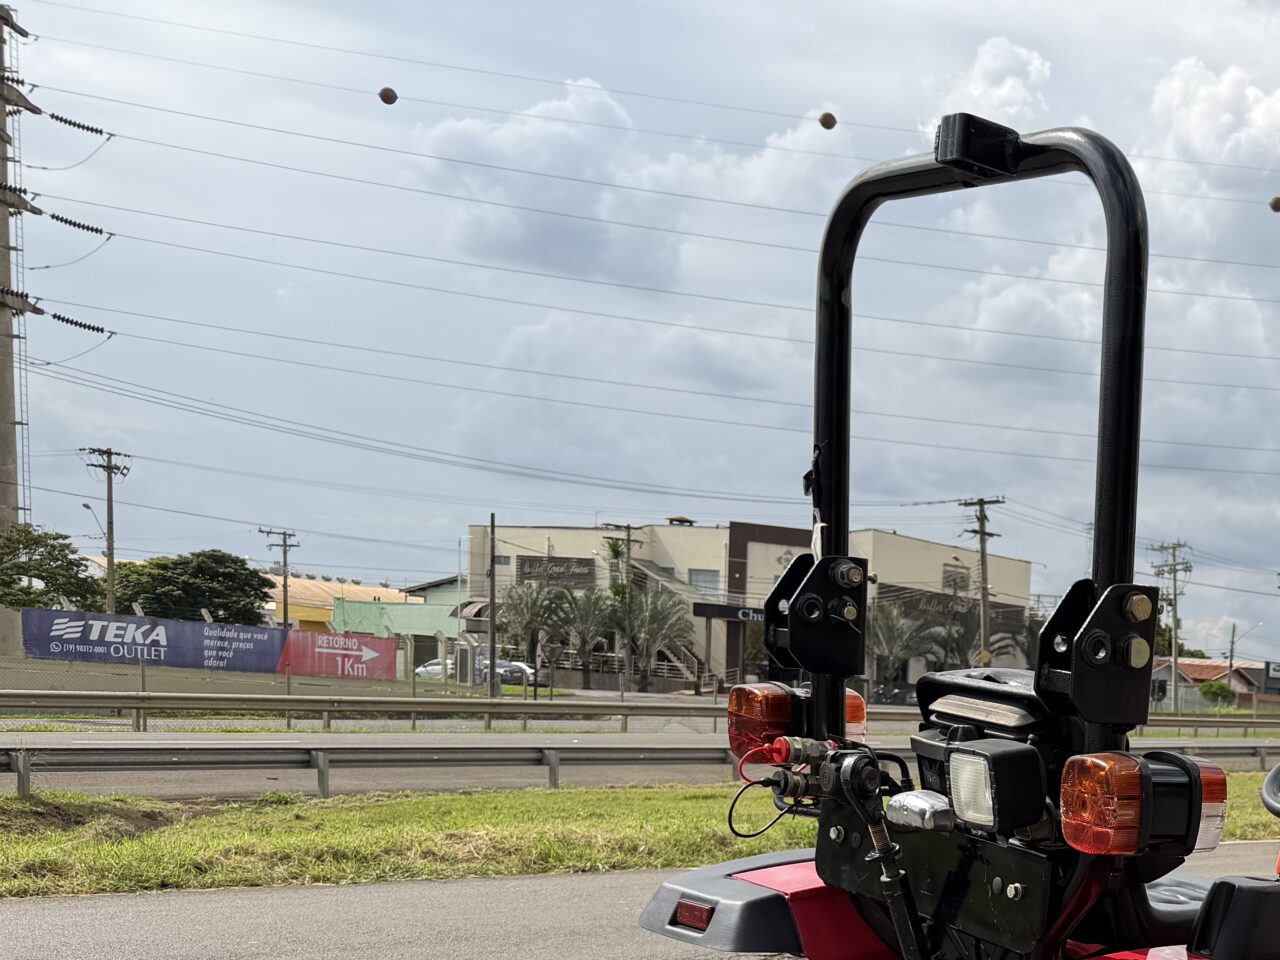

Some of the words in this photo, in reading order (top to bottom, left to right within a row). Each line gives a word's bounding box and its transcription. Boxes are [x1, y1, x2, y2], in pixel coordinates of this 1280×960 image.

[88, 620, 167, 645] TEKA
[203, 627, 238, 638] Qualidade
[240, 631, 251, 640] que
[253, 632, 268, 640] você
[63, 643, 75, 652] (19)
[203, 639, 230, 648] merece,
[232, 641, 254, 650] preços
[318, 635, 358, 649] RETORNO
[110, 644, 167, 660] OUTLET
[203, 649, 217, 658] que
[218, 649, 234, 658] você
[203, 657, 227, 667] adora!
[336, 656, 366, 677] 1Km
